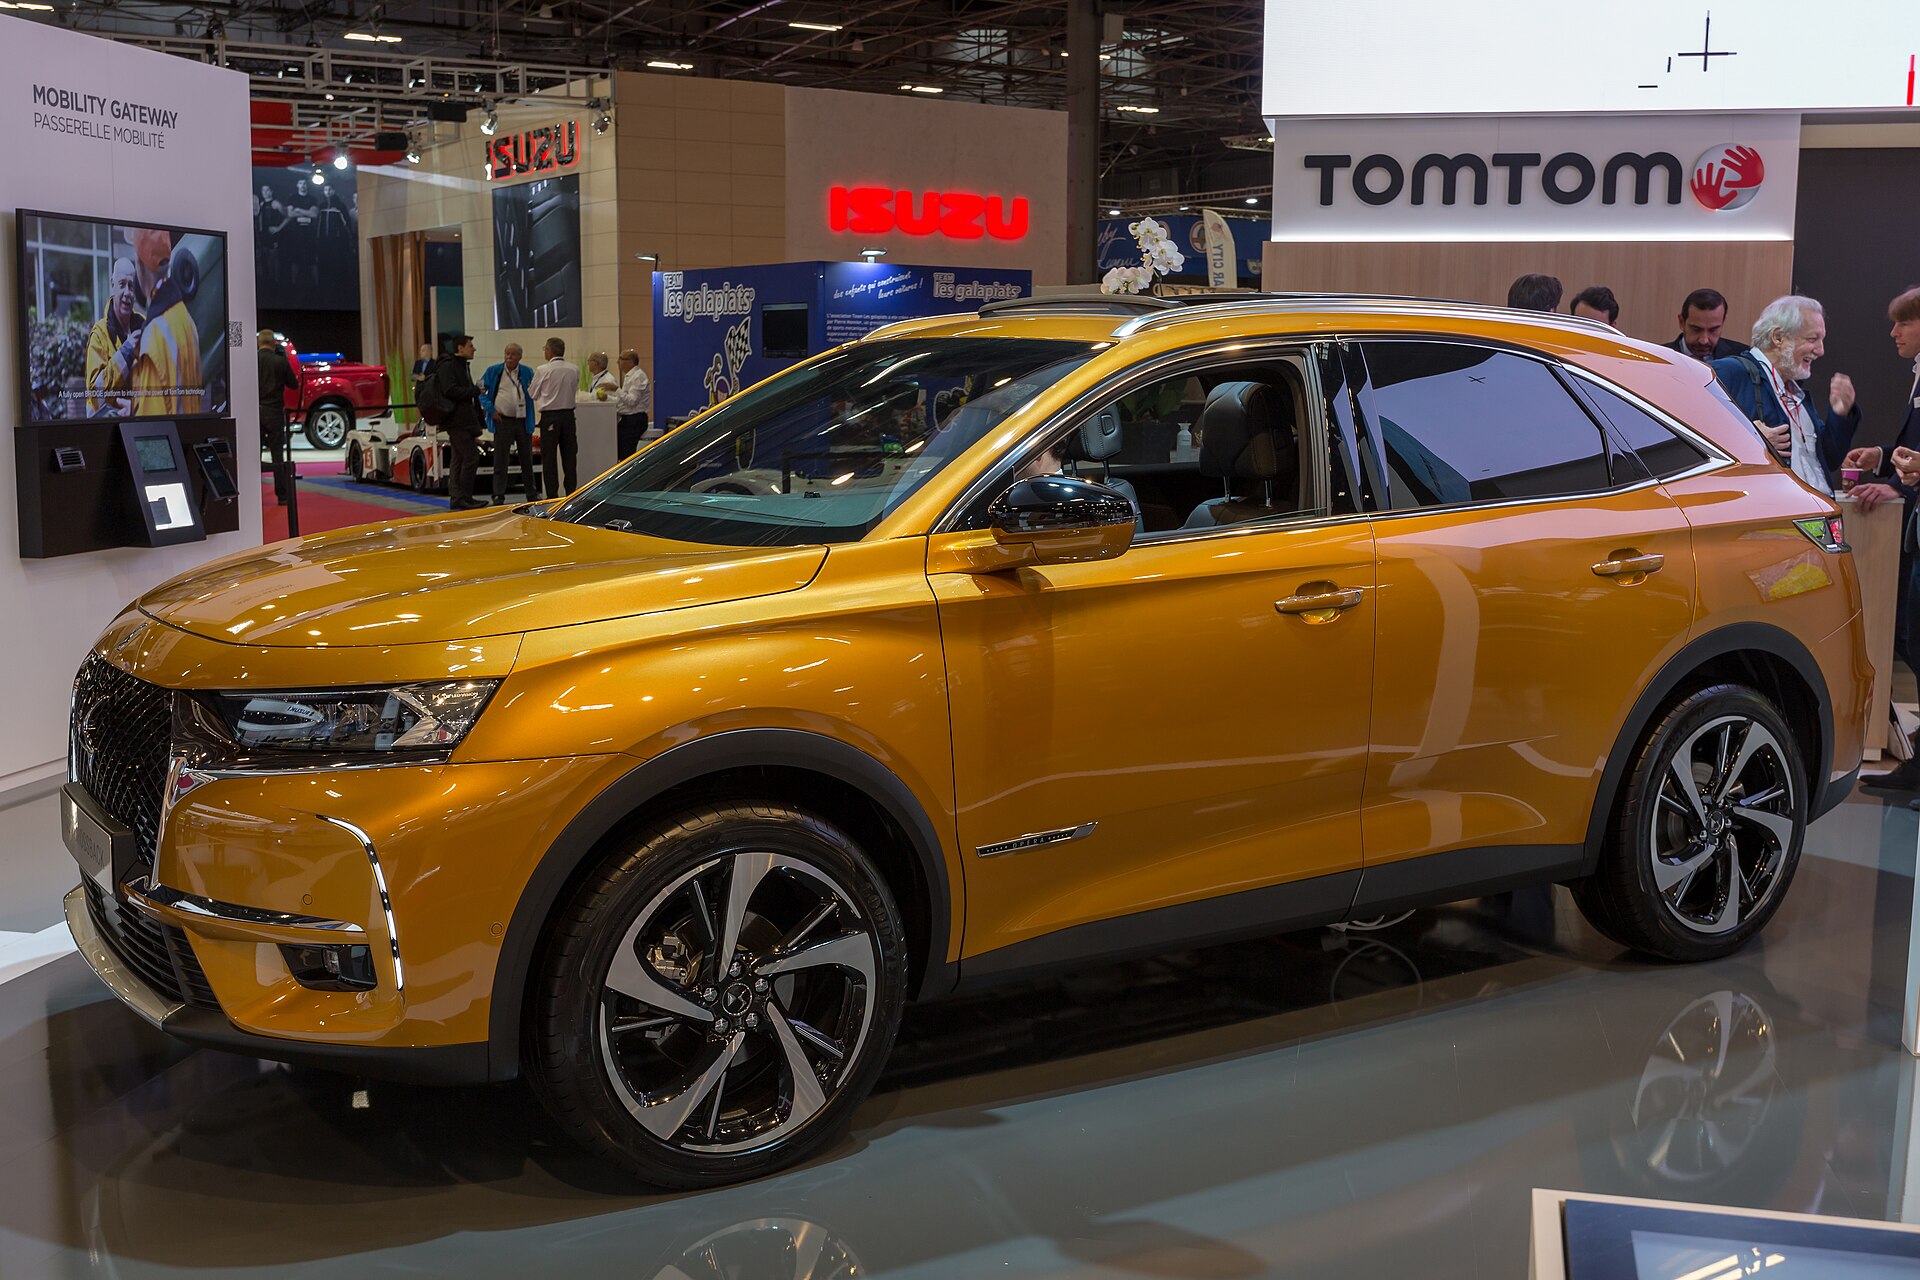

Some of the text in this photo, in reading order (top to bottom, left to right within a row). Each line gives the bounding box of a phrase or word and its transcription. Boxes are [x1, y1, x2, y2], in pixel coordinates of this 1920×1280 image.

[33, 84, 178, 129] MOBILITY GATEWAY
[34, 112, 165, 149] PASSERELLE MOBILITÉ
[485, 121, 580, 182] ISUZU
[830, 186, 1029, 240] ISUZU
[663, 272, 683, 289] TEAM
[867, 279, 877, 293] qui
[934, 280, 1021, 302] les galapiats
[663, 282, 755, 322] les galapiats
[63, 390, 72, 399] fully
[73, 391, 84, 399] open
[85, 390, 103, 398] BRIDGE
[104, 390, 121, 398] platform
[1012, 837, 1045, 849] OPERA
